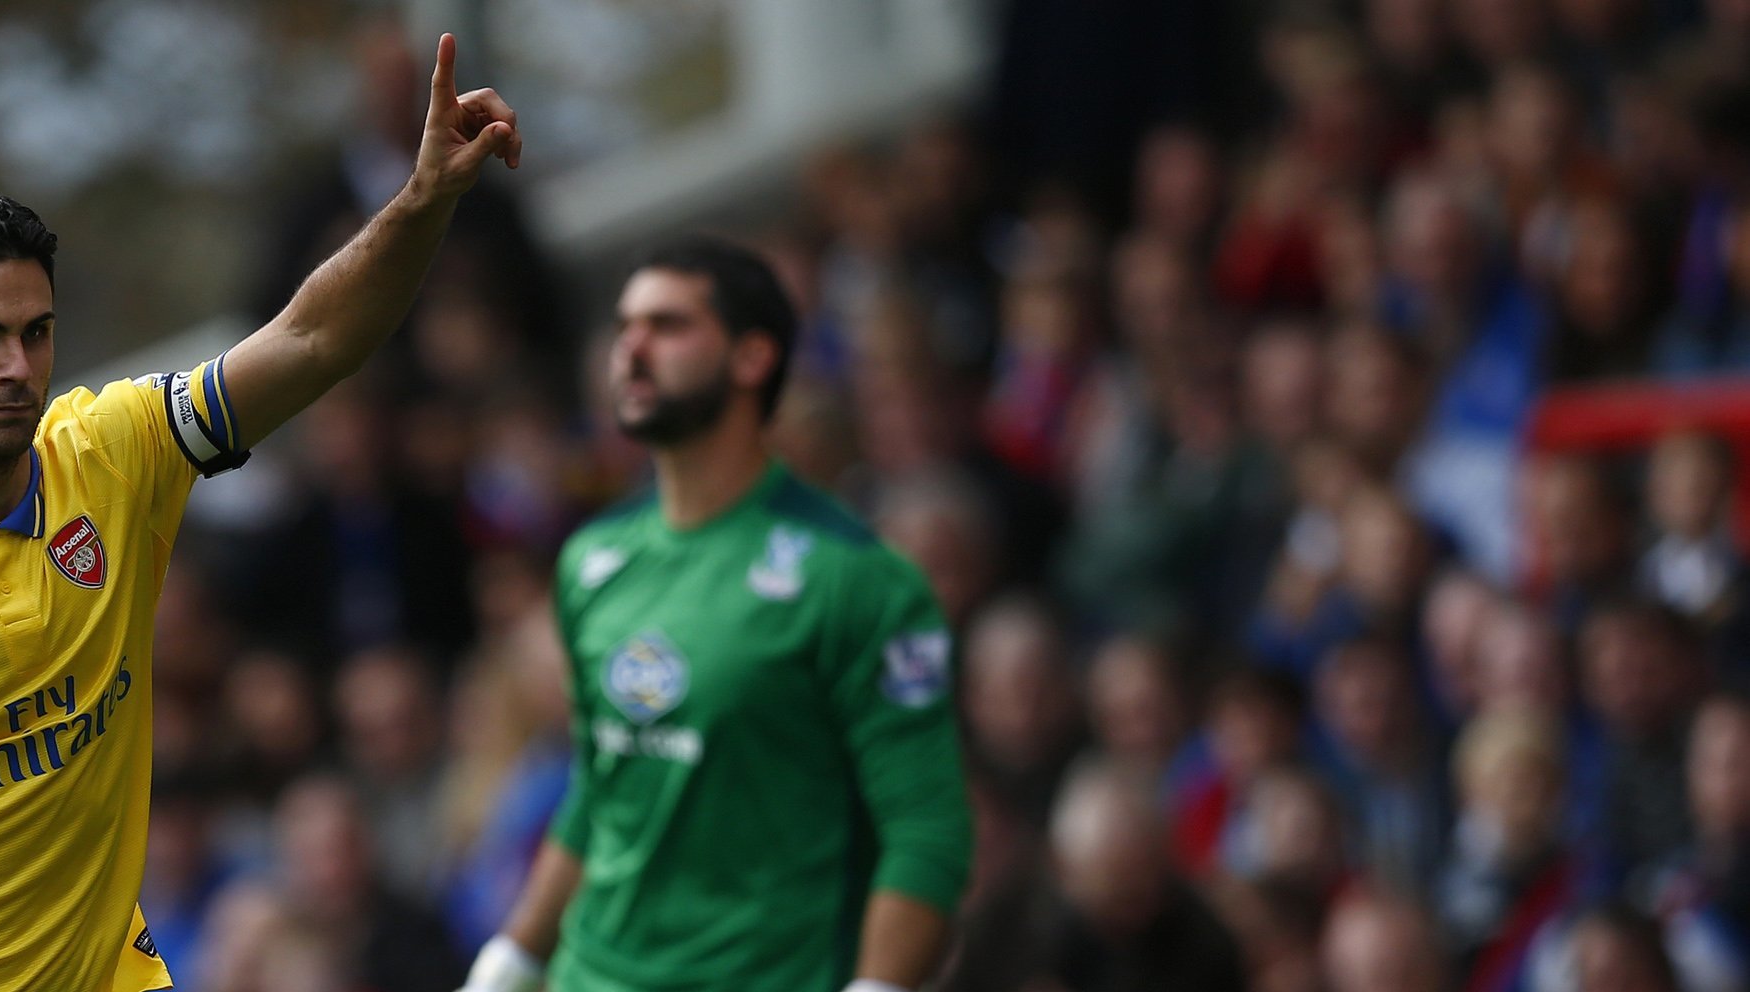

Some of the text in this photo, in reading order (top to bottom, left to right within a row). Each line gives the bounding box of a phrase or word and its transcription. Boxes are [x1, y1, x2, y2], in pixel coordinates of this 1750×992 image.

[177, 395, 190, 425] PREMIER
[183, 394, 194, 422] LEAGUE
[55, 524, 90, 559] Arsenal
[4, 675, 77, 734] Fly
